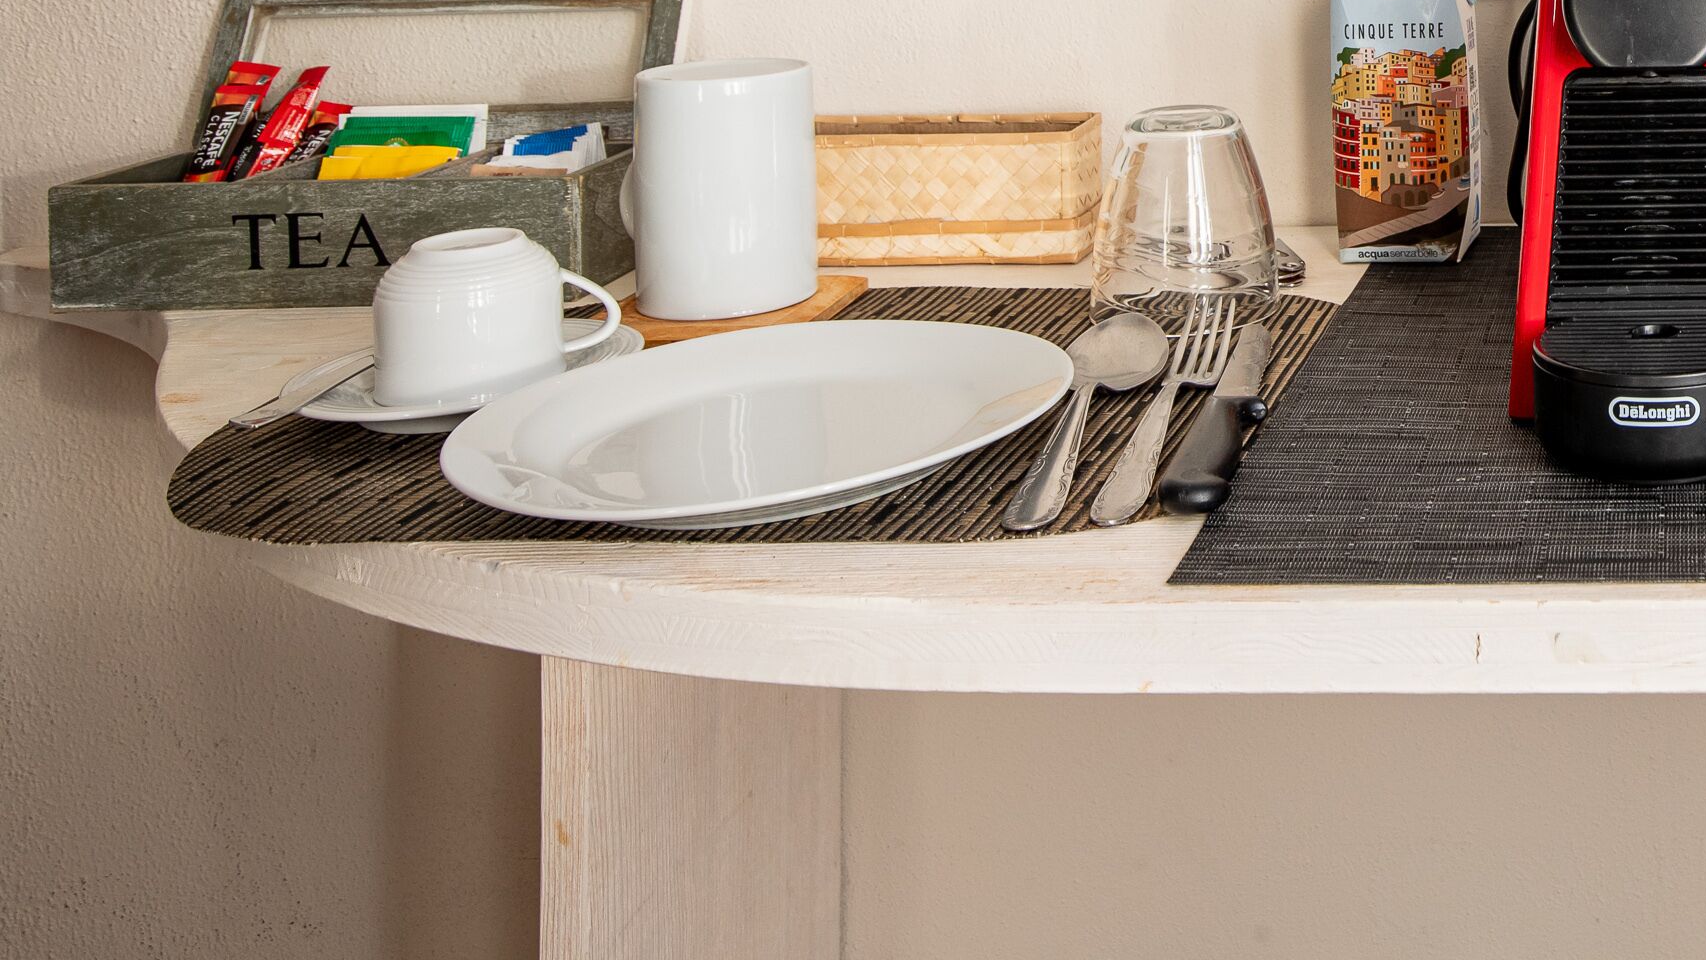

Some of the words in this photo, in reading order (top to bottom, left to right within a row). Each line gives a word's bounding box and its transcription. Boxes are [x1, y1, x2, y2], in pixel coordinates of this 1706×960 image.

[1344, 23, 1394, 40] CINQUE
[1402, 22, 1444, 39] TERRE
[193, 114, 220, 165] CLASSIC
[231, 212, 392, 271] TEA
